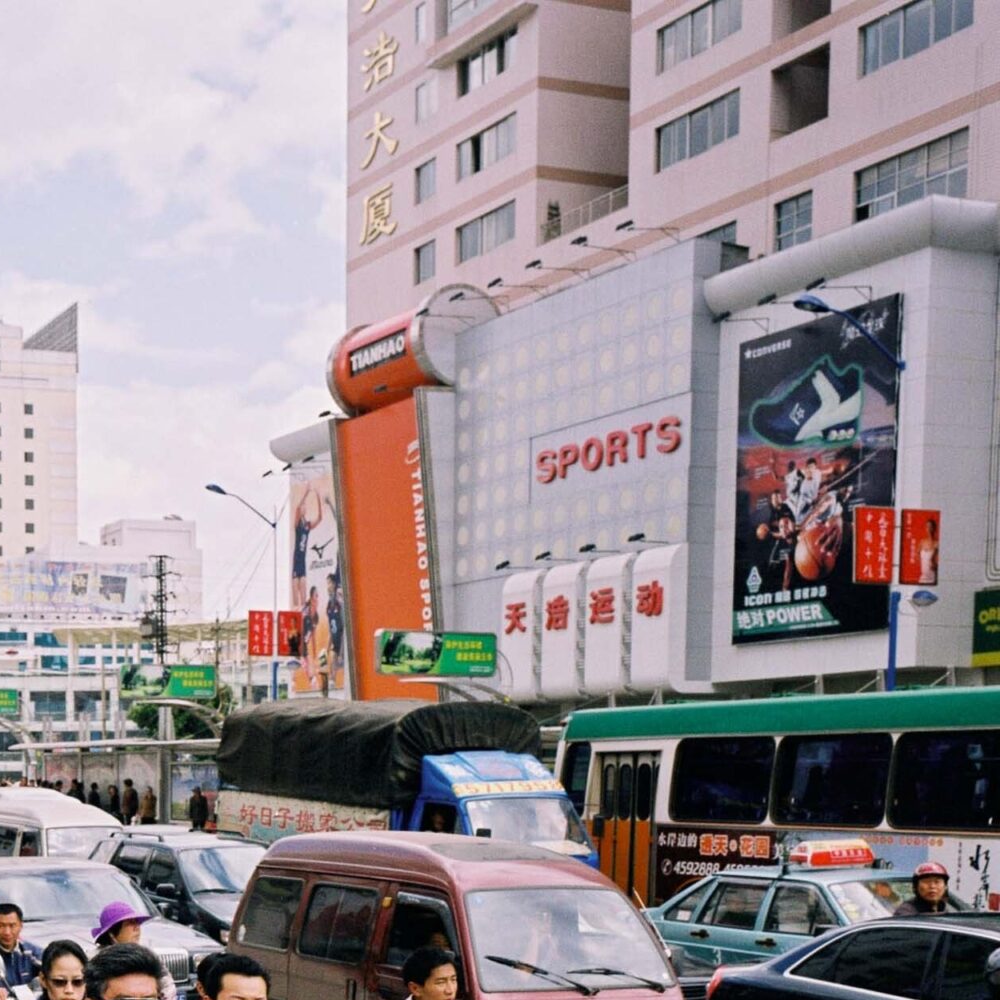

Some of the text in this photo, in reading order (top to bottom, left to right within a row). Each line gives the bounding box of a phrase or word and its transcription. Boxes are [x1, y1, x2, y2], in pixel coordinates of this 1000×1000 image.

[360, 0, 399, 246] 浩大厦
[350, 334, 405, 372] TIANHAO
[536, 416, 682, 484] SPORTS
[409, 468, 428, 570] TIANHAO
[504, 580, 664, 635] 天浩运动
[737, 609, 765, 630] 绝对
[767, 603, 824, 624] POWER
[978, 606, 1000, 624] OR
[673, 860, 720, 876] 4592888
